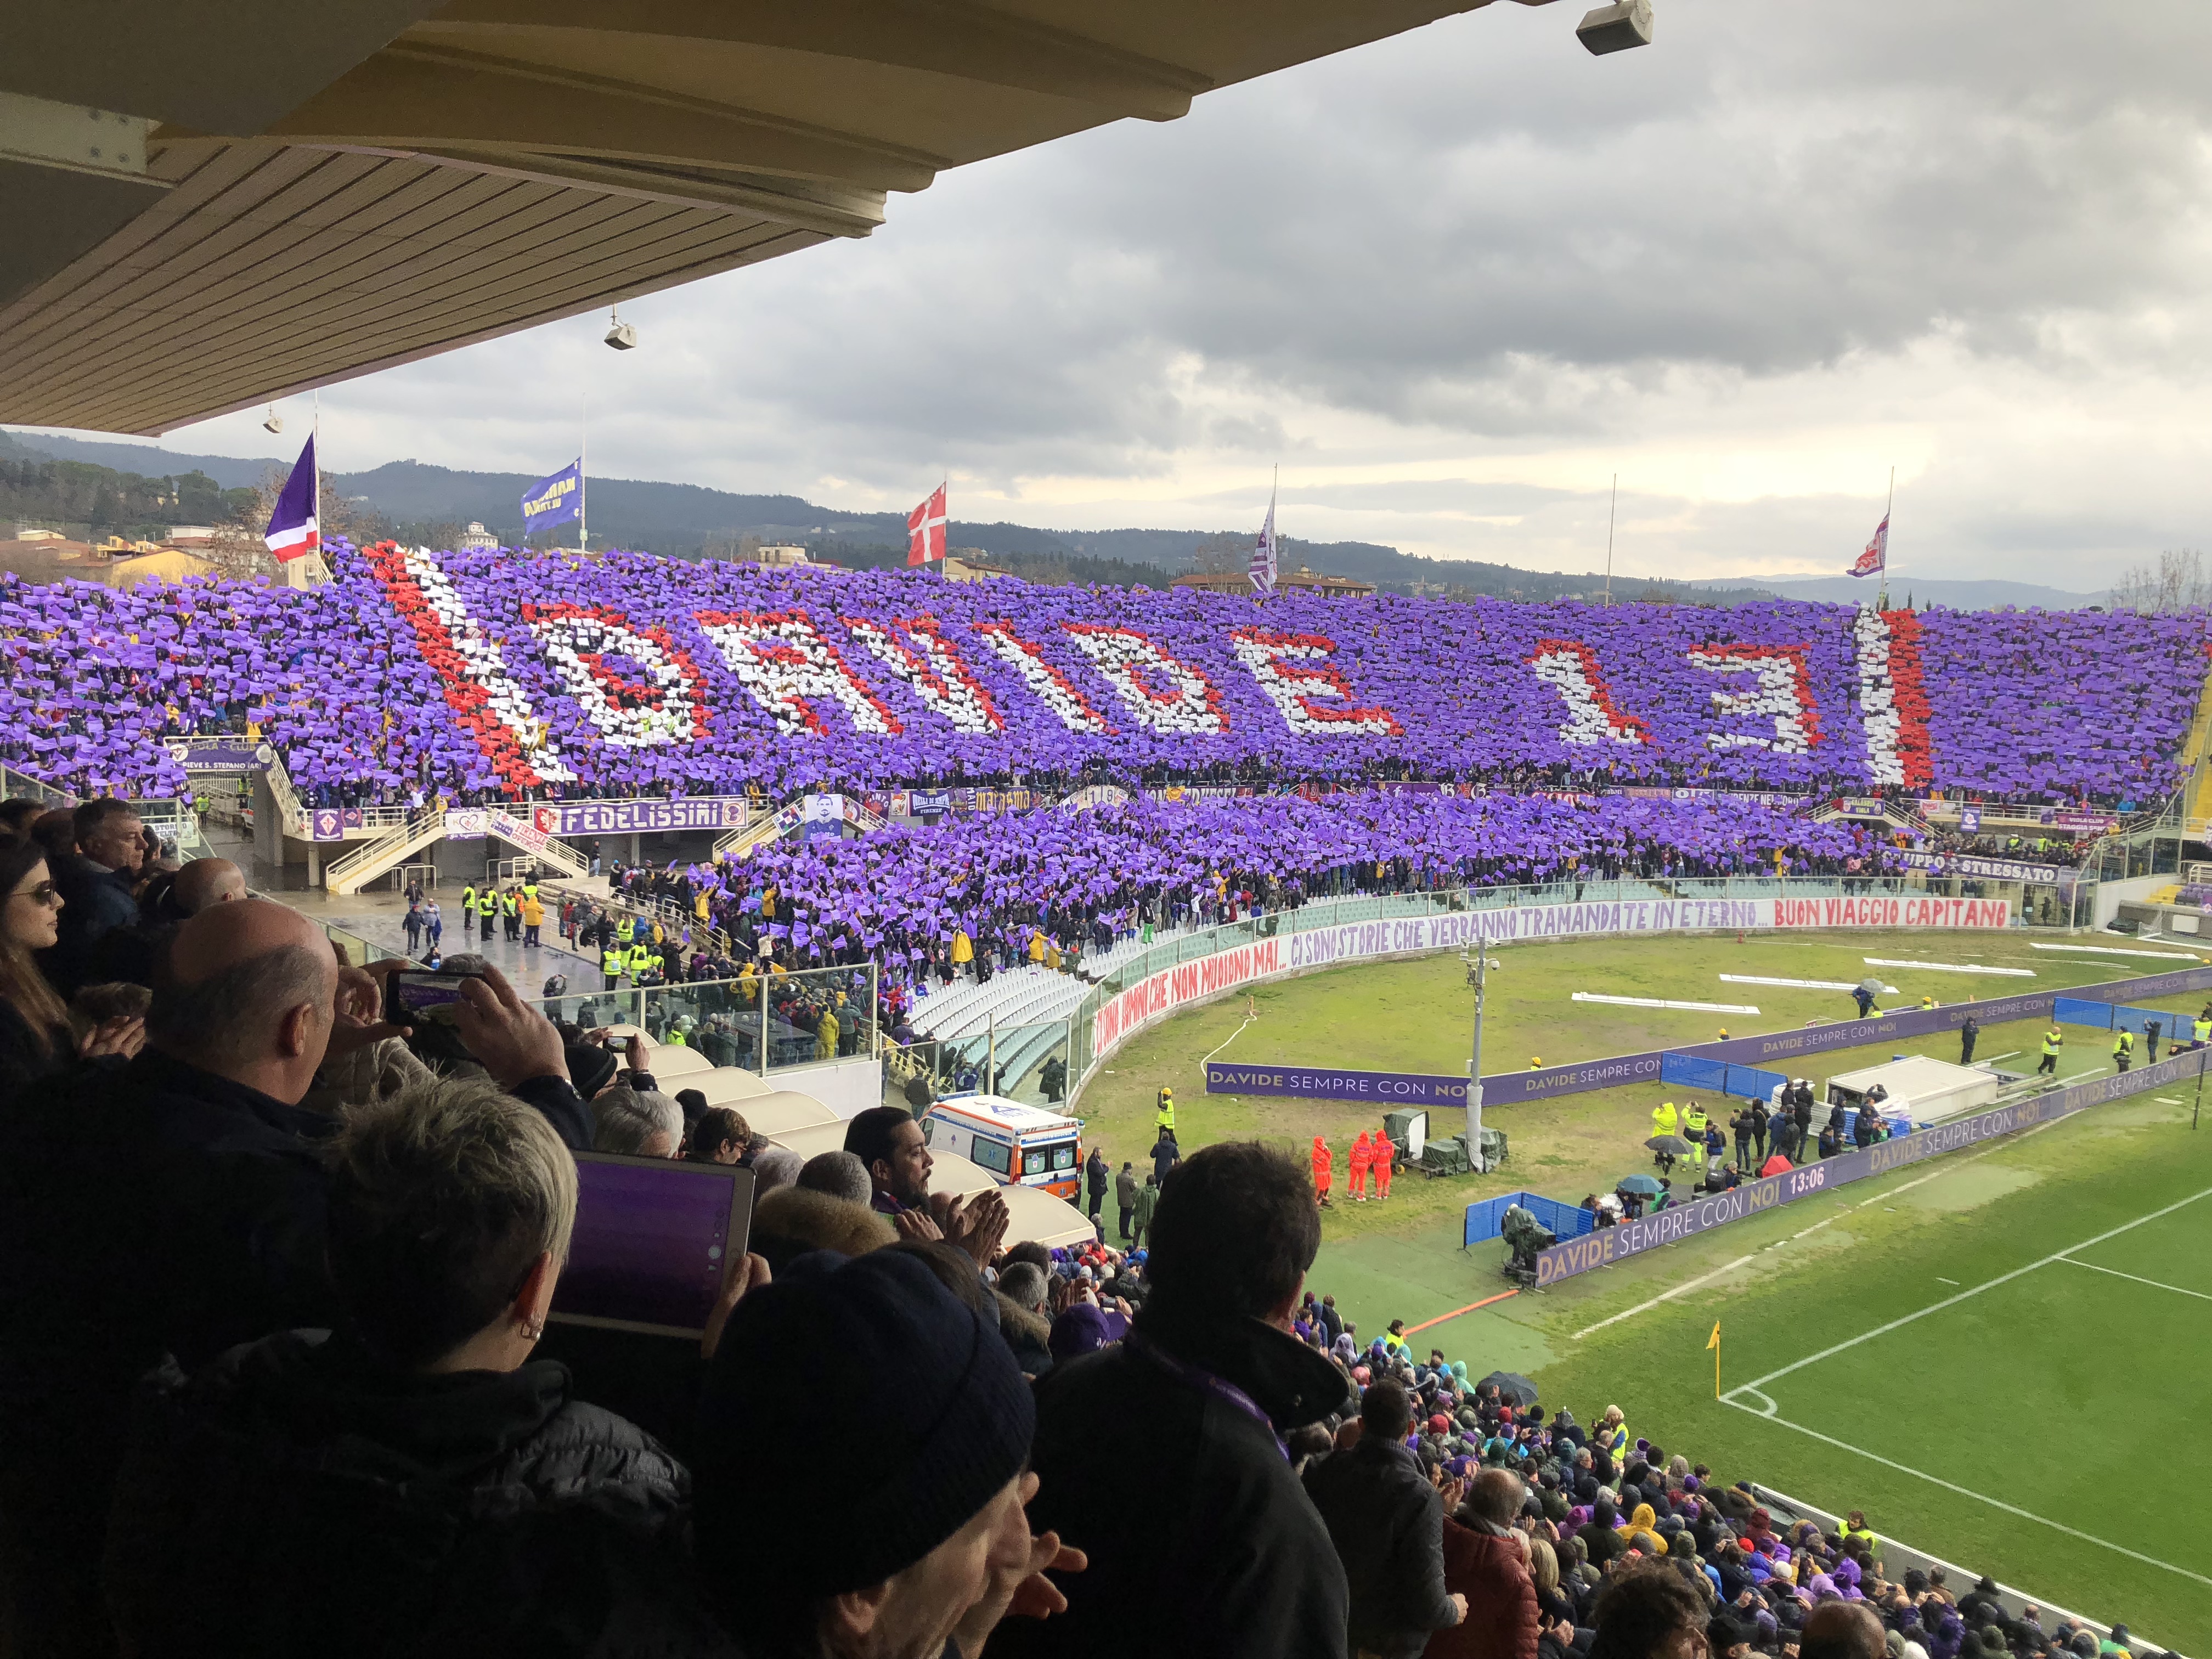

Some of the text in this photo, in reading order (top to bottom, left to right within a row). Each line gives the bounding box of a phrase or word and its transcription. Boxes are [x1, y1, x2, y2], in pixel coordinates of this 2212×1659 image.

[521, 600, 1826, 754] DAVIDE 13
[566, 803, 718, 831] FEDELISSIMI
[515, 822, 549, 845] FIRENZE
[1962, 859, 2055, 882] STRESSATO
[1775, 899, 2007, 928] BUON VIAGGIO CAPITANO
[1291, 934, 1303, 966] CI
[1305, 929, 1337, 964] SONO
[1338, 922, 1391, 957] STORIE
[1393, 920, 1425, 950] CHE
[1428, 910, 1517, 946] VERRANNO
[1521, 902, 1649, 936] TRAMANDATE
[1653, 901, 1676, 929] IN
[1149, 973, 1169, 1014] CHE
[1171, 963, 1198, 1004] NON
[1200, 948, 1250, 995] MUOIONO
[1986, 1002, 2022, 1017] SEMPRE
[2024, 999, 2046, 1012] CON
[1763, 1037, 1804, 1053] DAVIDE
[1805, 1027, 1847, 1046] SEMPRE
[1850, 1025, 1875, 1039] CON
[1210, 1071, 1468, 1097] DAVIDE SEMPRE CON NO
[1526, 1073, 1577, 1092] DAVIDE
[1579, 1063, 1631, 1084] SEMPRE
[1635, 1059, 1662, 1074] CON
[2064, 1082, 2107, 1110] DAVIDE
[2109, 1069, 2151, 1098] SEMPRE
[2154, 1062, 2176, 1084] CON
[1870, 1101, 2041, 1171] DAVIDE SEMPRE CON NOI
[1789, 1166, 1825, 1195] 13:06
[1538, 1180, 1781, 1283] DAVIDE SEMPRE CON NOI
